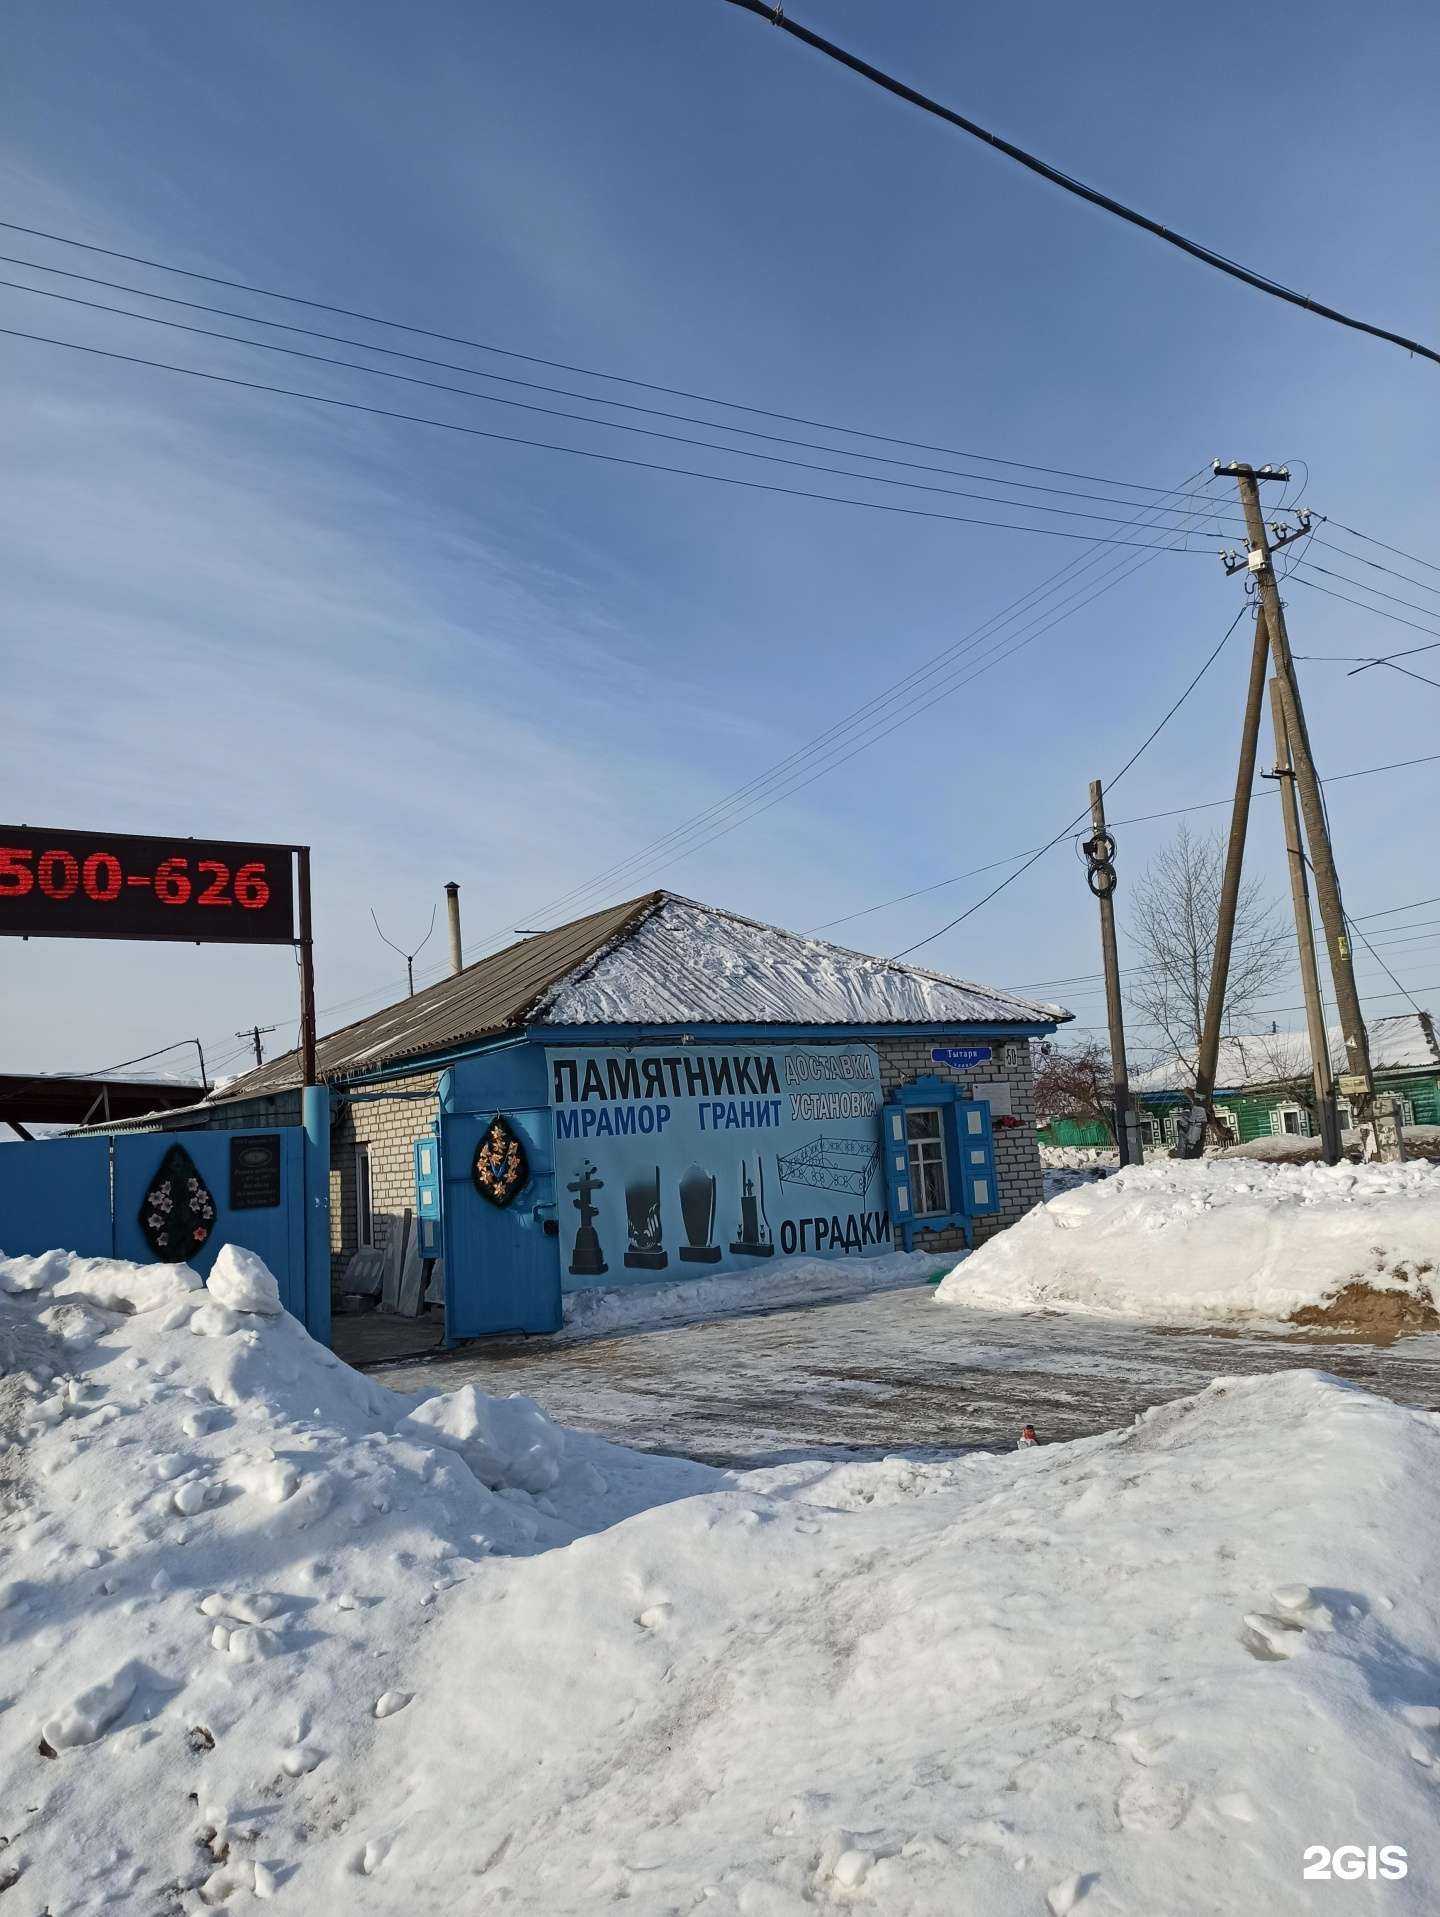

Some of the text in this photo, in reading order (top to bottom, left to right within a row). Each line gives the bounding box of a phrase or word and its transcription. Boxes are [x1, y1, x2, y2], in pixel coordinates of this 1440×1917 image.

[0, 847, 270, 909] 500-626
[553, 1056, 781, 1103] ПАМЯТНИКИ
[784, 1054, 875, 1086] ДОСТАВКА
[556, 1100, 782, 1139] МРАМОР ГРАНИТ
[789, 1091, 878, 1121] УСТАНОВКА
[780, 1210, 892, 1255] ОГРАДКИ
